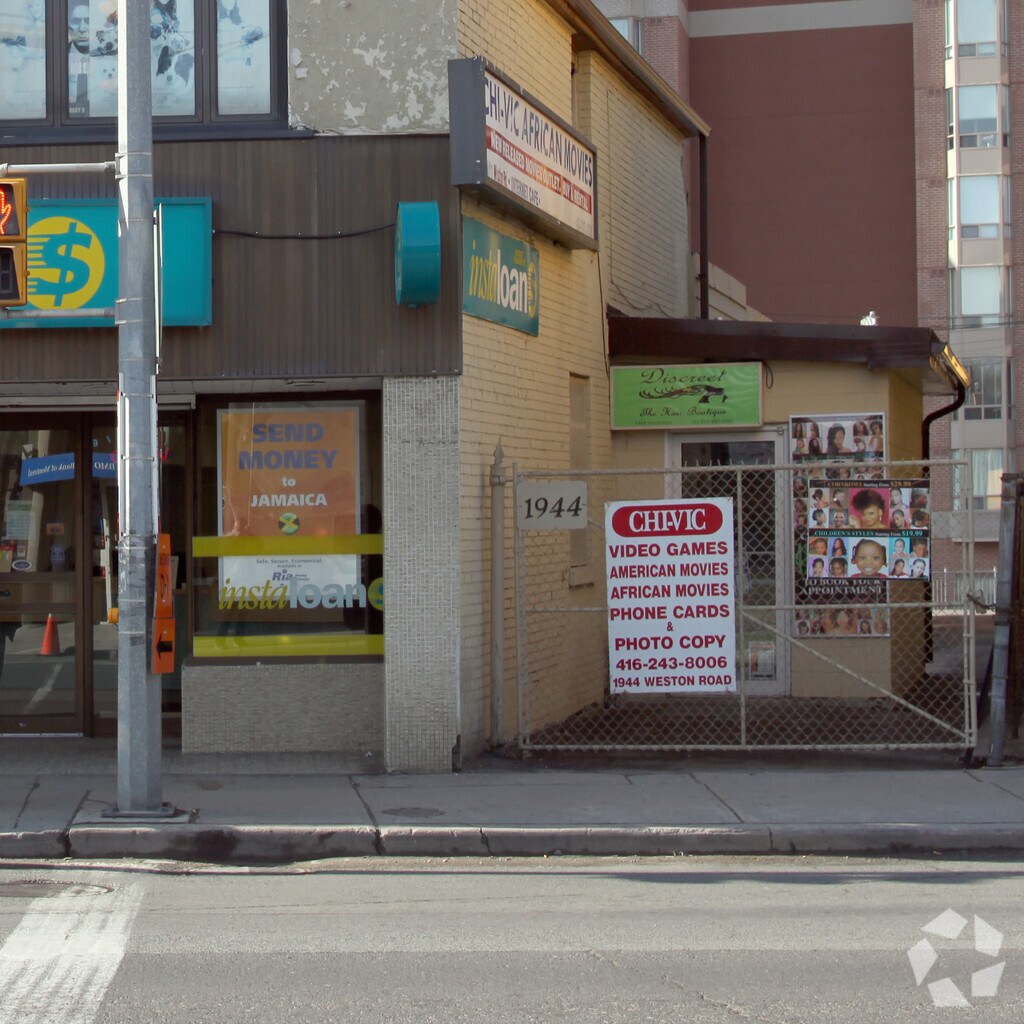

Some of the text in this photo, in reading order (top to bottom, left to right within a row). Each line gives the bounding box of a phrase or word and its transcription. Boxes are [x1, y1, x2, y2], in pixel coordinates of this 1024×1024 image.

[521, 107, 563, 166] AFRICAN
[563, 136, 593, 188] MOVIES
[641, 367, 728, 384] Discreet
[639, 407, 656, 418] The
[686, 406, 727, 418] Boutique
[252, 423, 324, 443] SEND
[238, 449, 338, 470] MONEY
[281, 476, 296, 488] to
[250, 493, 328, 507] JAMAICA
[524, 496, 582, 520] 1944
[628, 508, 706, 533] CHI-VIC
[609, 541, 728, 558] VIDEO GAMES
[609, 562, 729, 579] AMERICAN MOVIES
[610, 583, 729, 600] AFRICAN MOVIES
[610, 604, 730, 621] PHONE CARDS
[666, 621, 674, 632] &
[614, 634, 726, 651] PHOTO COPY
[615, 656, 728, 671] 416-243-8006
[613, 675, 732, 688] 1944 WESTON ROAD
